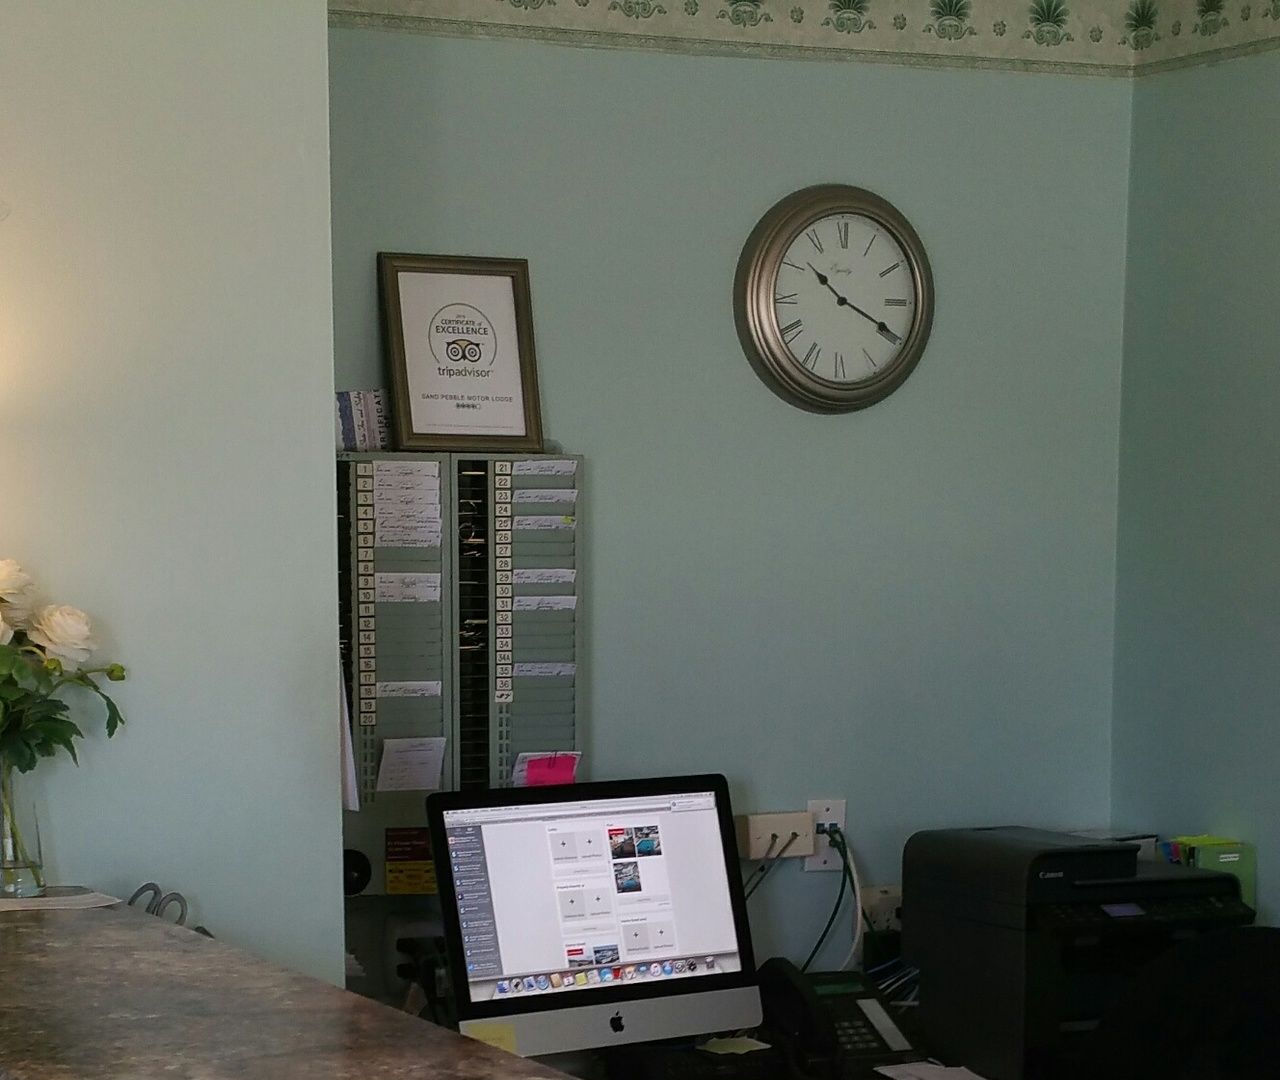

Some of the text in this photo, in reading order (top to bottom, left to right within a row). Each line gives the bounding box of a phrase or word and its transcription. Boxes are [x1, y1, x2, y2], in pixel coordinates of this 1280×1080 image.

[440, 318, 476, 327] CERTIFICATE
[435, 326, 489, 336] EXCELLENCE
[437, 366, 491, 378] tripadvisor
[499, 464, 508, 472] 21
[498, 477, 508, 486] 22
[498, 492, 509, 500] 23
[498, 506, 508, 514] 24
[499, 519, 509, 528] 25
[499, 533, 509, 542] 26
[499, 546, 509, 555] 27
[499, 560, 510, 568] 28
[499, 573, 510, 581] 29
[362, 591, 371, 600] 10
[499, 587, 509, 596] 30
[499, 600, 509, 609] 31
[364, 606, 370, 614] 11
[499, 613, 509, 622] 32
[363, 619, 371, 628] 12
[499, 627, 510, 636] 33
[363, 634, 371, 642] 14
[499, 640, 510, 649] 34
[499, 667, 510, 676] 35
[363, 674, 372, 682] 17
[499, 680, 510, 689] 36
[362, 715, 373, 724] 20
